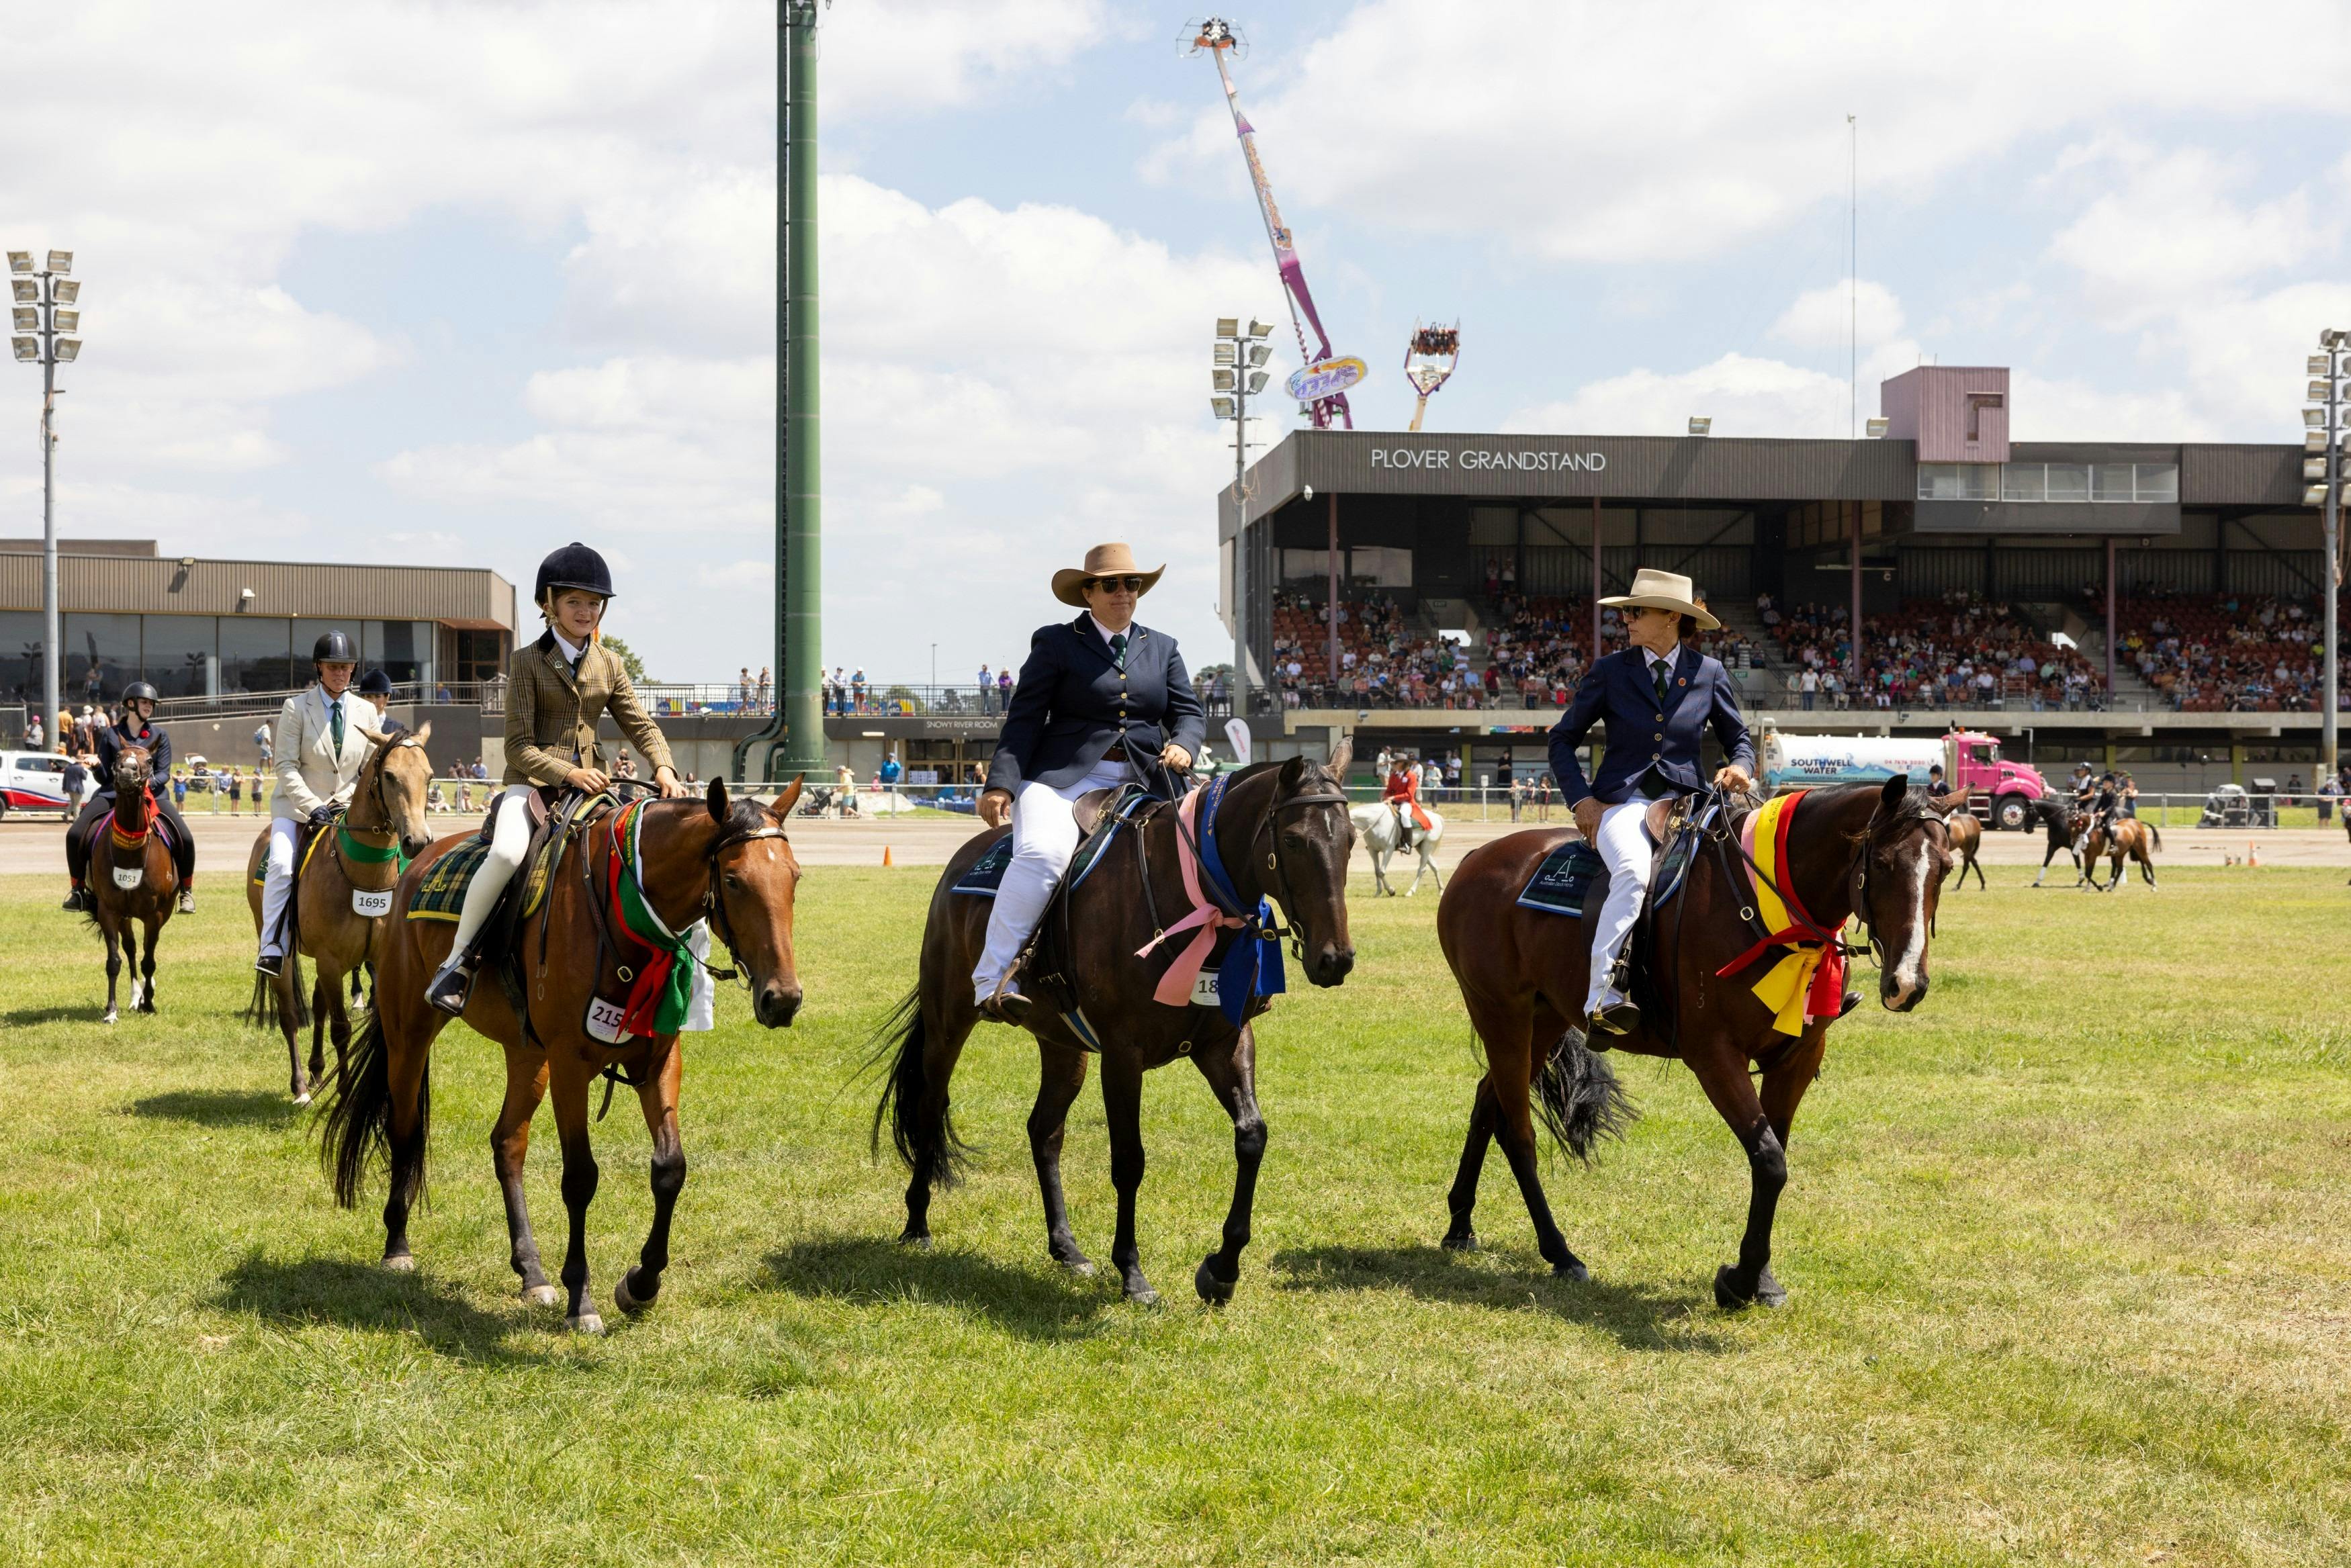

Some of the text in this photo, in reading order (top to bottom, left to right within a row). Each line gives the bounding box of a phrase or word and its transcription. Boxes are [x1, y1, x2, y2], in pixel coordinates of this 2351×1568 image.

[1371, 449, 1607, 472] PLOVER GRANDSTAND
[1883, 573, 1892, 582] C
[927, 721, 998, 729] SNOWY RIVER ROOM
[1791, 759, 1853, 767] SOUTHWELL
[118, 874, 137, 883] 1051
[358, 896, 386, 909] 1695
[1198, 979, 1218, 993] 18
[592, 1006, 630, 1031] 215
